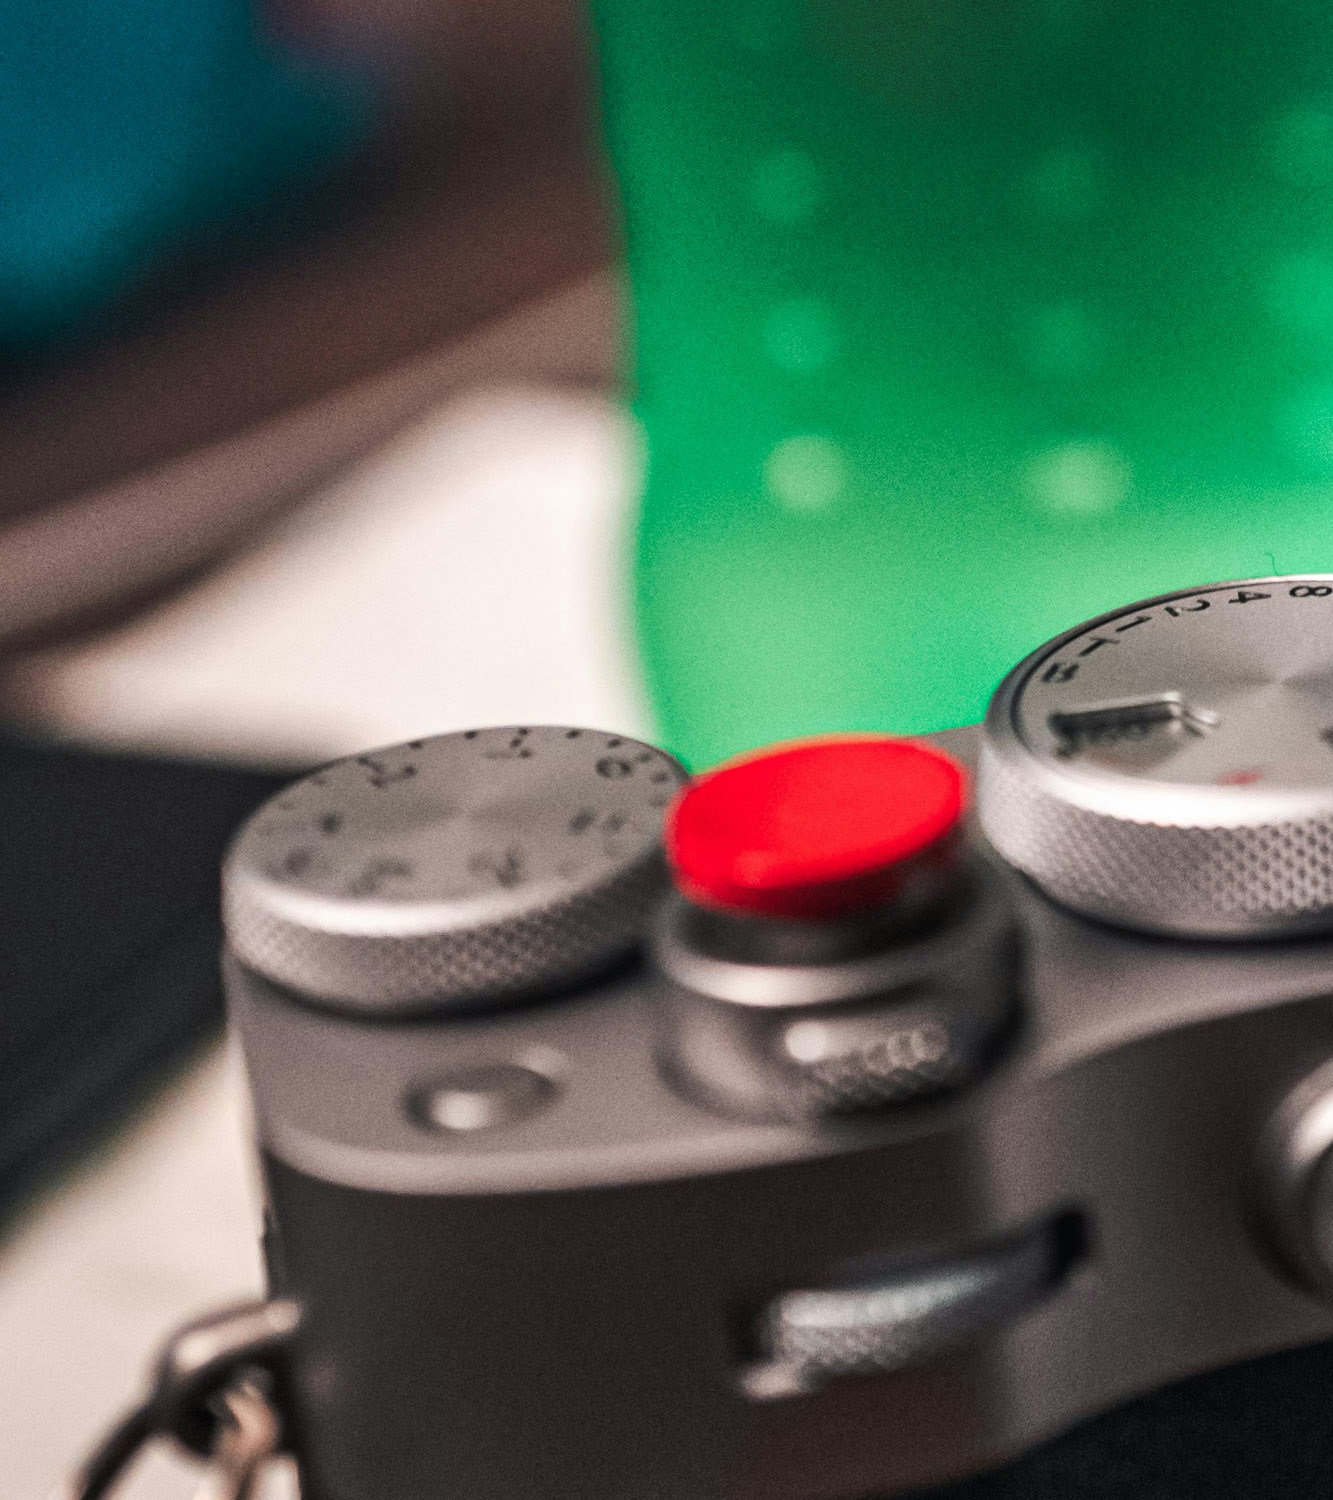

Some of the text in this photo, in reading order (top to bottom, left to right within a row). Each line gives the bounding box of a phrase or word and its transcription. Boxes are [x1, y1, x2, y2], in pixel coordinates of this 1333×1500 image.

[1079, 635, 1121, 658] T
[1115, 615, 1153, 633] 1
[1163, 598, 1211, 618] 2
[1228, 590, 1272, 605] 4
[1288, 585, 1333, 598] 8
